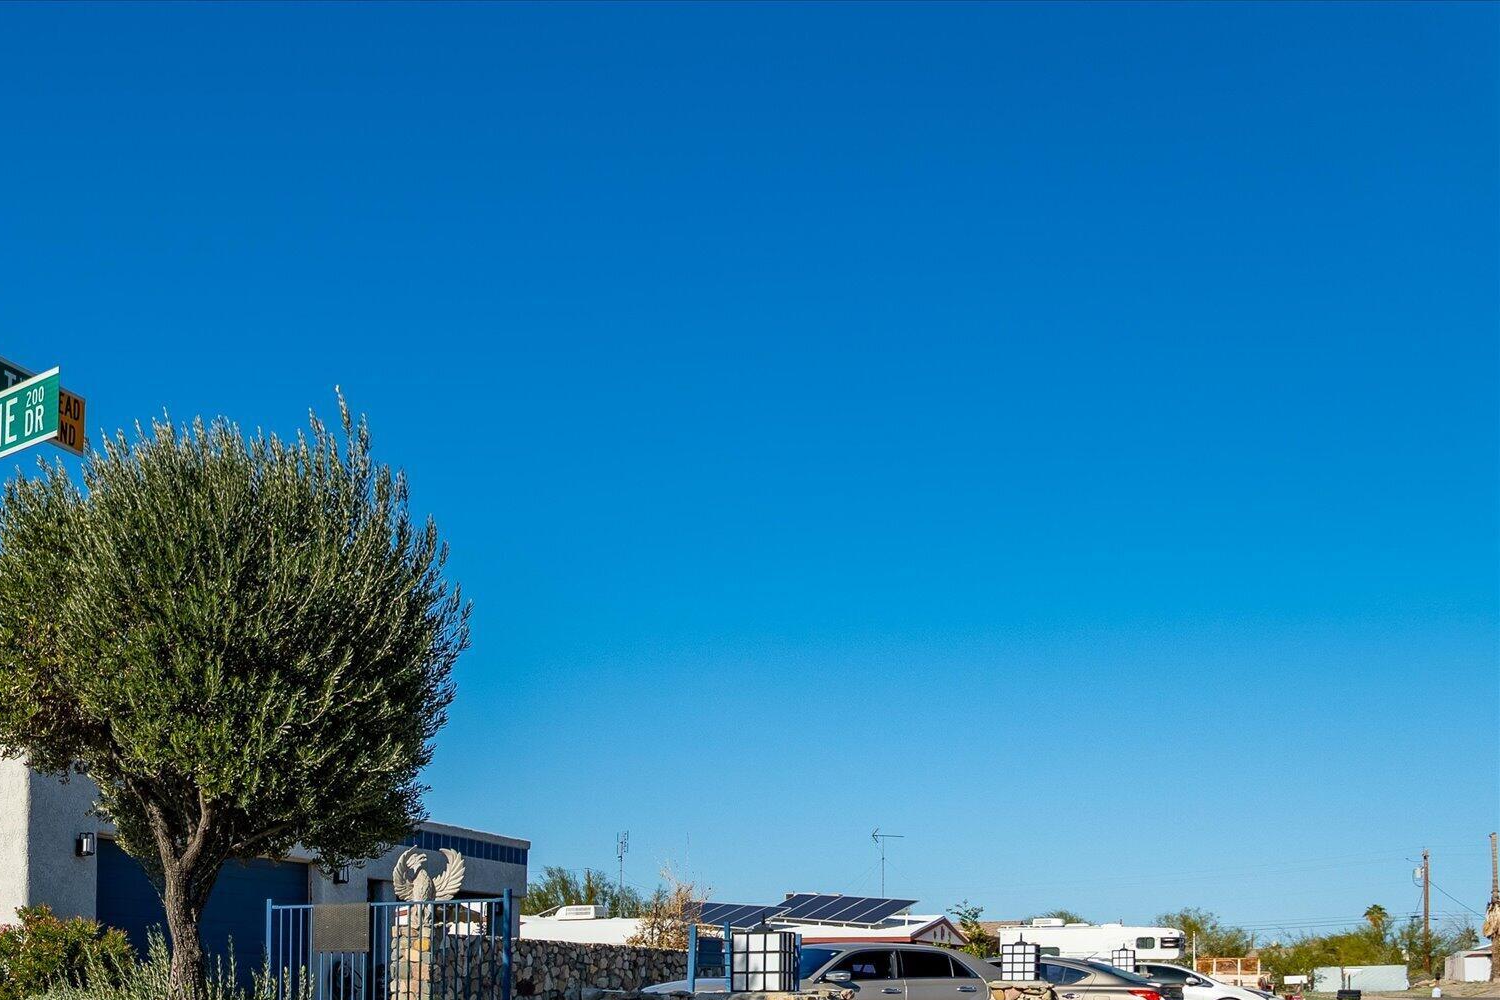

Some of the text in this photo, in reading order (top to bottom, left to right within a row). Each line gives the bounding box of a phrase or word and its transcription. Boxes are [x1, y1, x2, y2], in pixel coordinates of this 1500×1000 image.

[26, 386, 45, 408] 200
[60, 391, 80, 421] EAD
[25, 405, 45, 437] DR
[60, 421, 76, 446] ND
